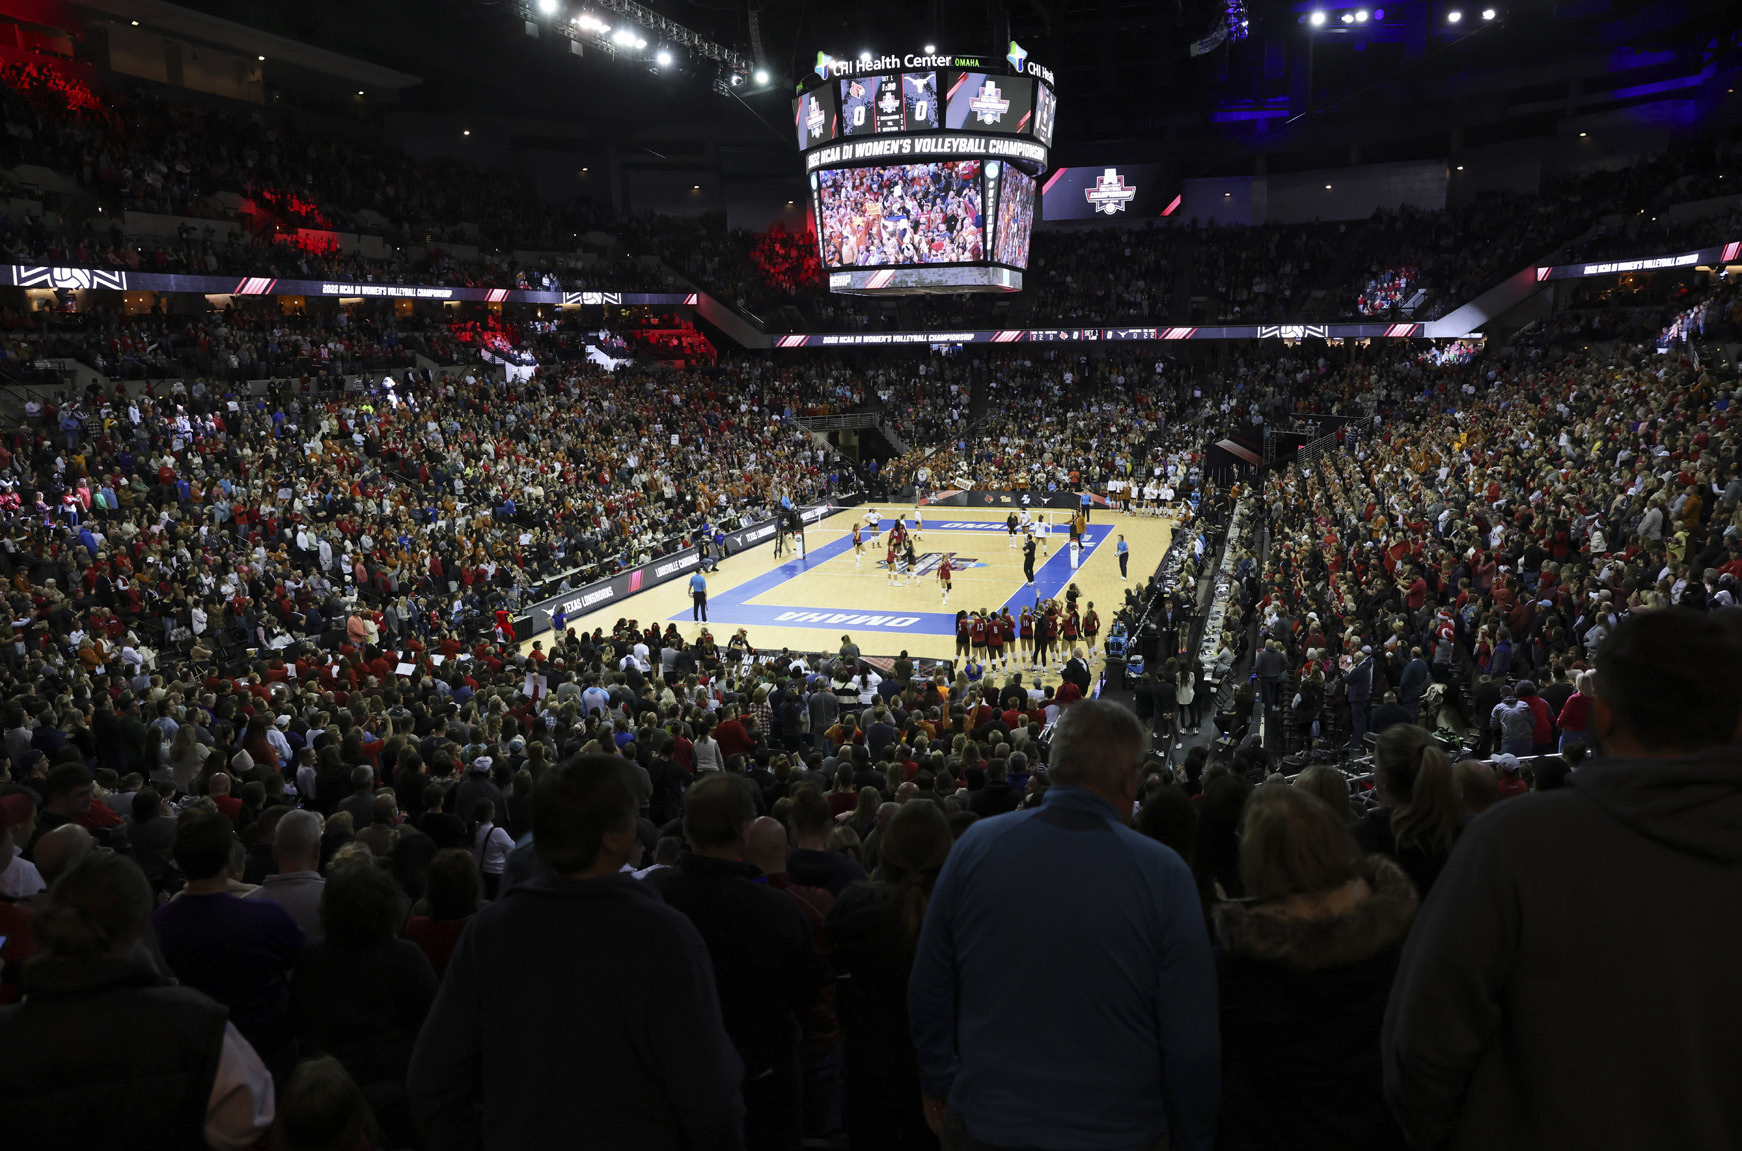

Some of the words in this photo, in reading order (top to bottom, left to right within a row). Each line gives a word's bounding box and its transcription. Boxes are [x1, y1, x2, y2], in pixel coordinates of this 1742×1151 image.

[833, 60, 853, 77] CHI
[856, 54, 900, 72] Health
[904, 54, 952, 68] Center
[954, 58, 980, 67] OMAHA
[1028, 62, 1041, 78] CHI
[853, 106, 866, 126] 0
[914, 100, 928, 121] 0
[820, 146, 840, 164] NCAA
[842, 144, 853, 160] DI
[855, 138, 911, 158] WOMEN'S
[914, 138, 986, 153] VOLLEYBALL
[988, 140, 1045, 161] CHAMPIONSHIP
[323, 284, 338, 294] 2022
[339, 285, 354, 294] NCAA
[362, 286, 387, 295] WOMEN'S
[388, 287, 416, 296] VOLLEYBALL
[417, 288, 452, 298] CHAMPIONSHIP
[1073, 331, 1079, 340] 0
[1107, 331, 1113, 339] 0
[655, 560, 680, 578] LOUISVILLE
[563, 598, 582, 614] TEXAS
[582, 586, 614, 606] LONGHORNS
[774, 611, 921, 627] OMAHA
